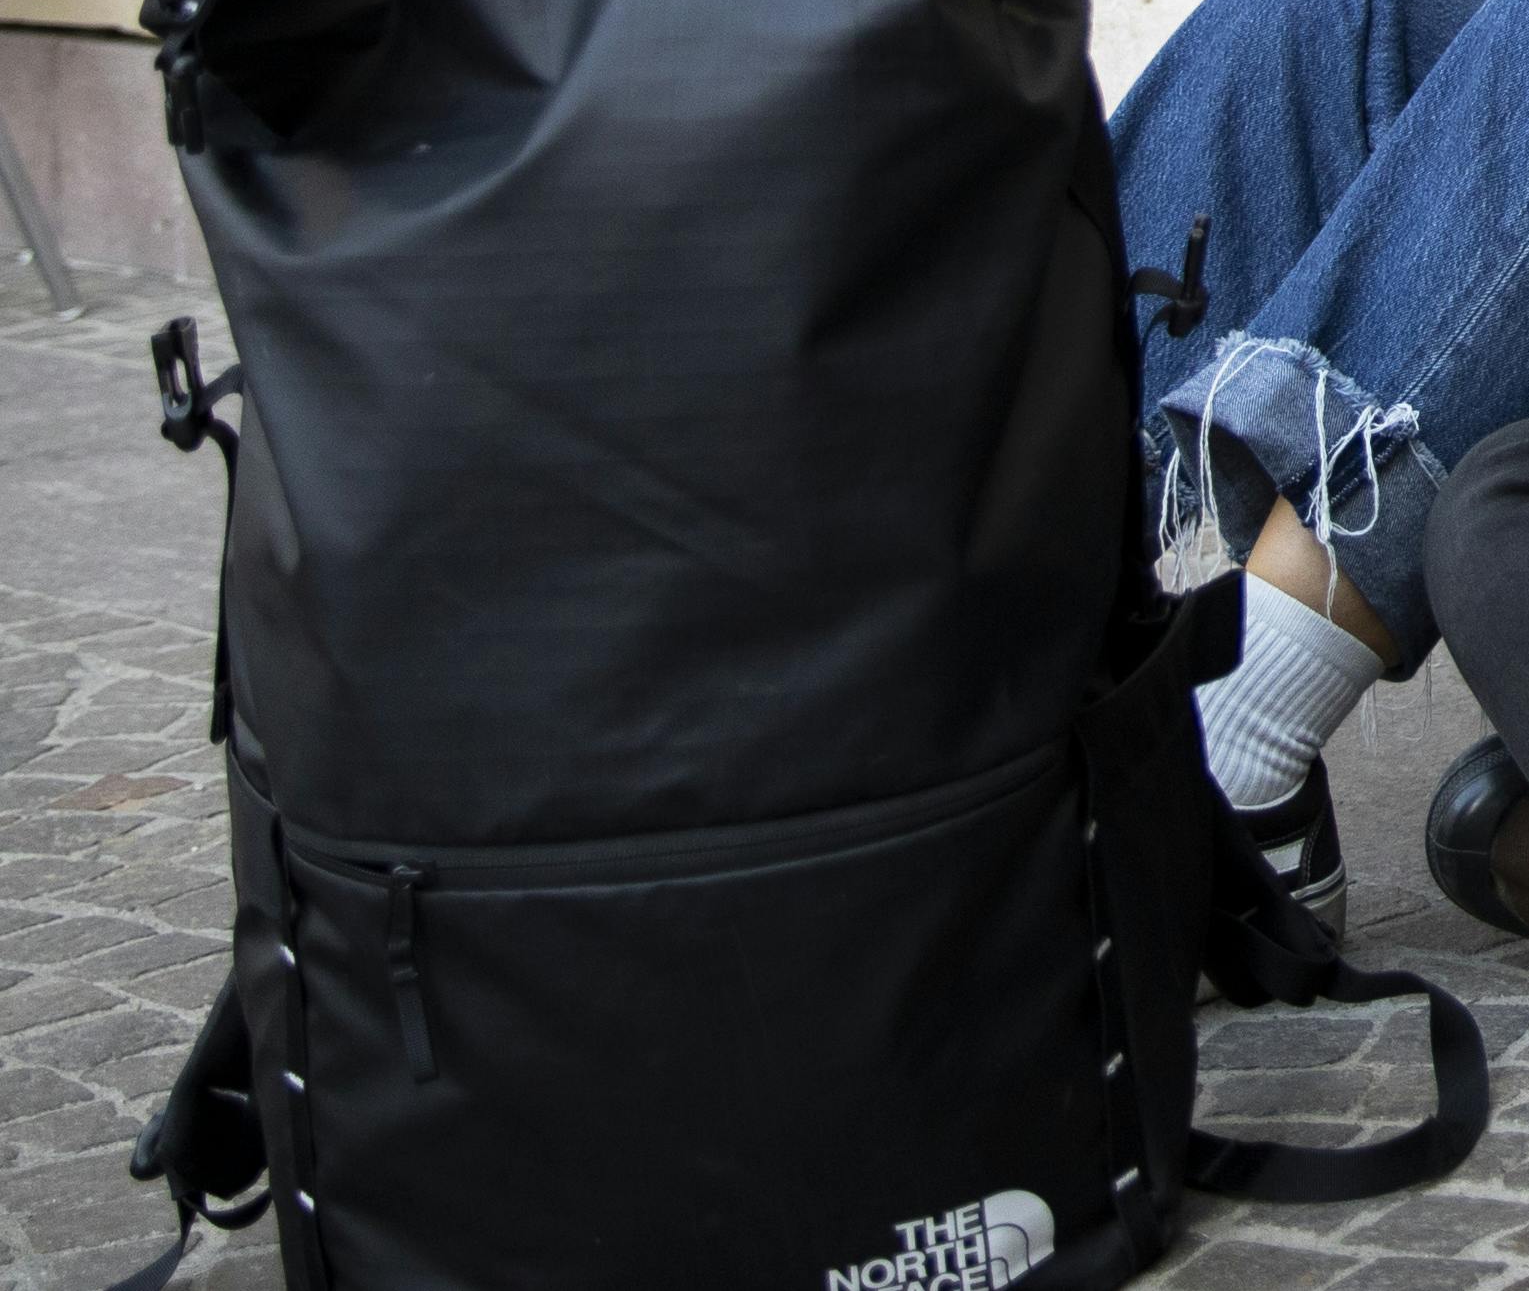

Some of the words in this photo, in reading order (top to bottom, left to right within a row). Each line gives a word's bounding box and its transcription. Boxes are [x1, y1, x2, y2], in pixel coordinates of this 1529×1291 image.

[894, 1201, 984, 1251] THE
[826, 1231, 987, 1291] NORTH
[877, 1265, 989, 1291] CE
